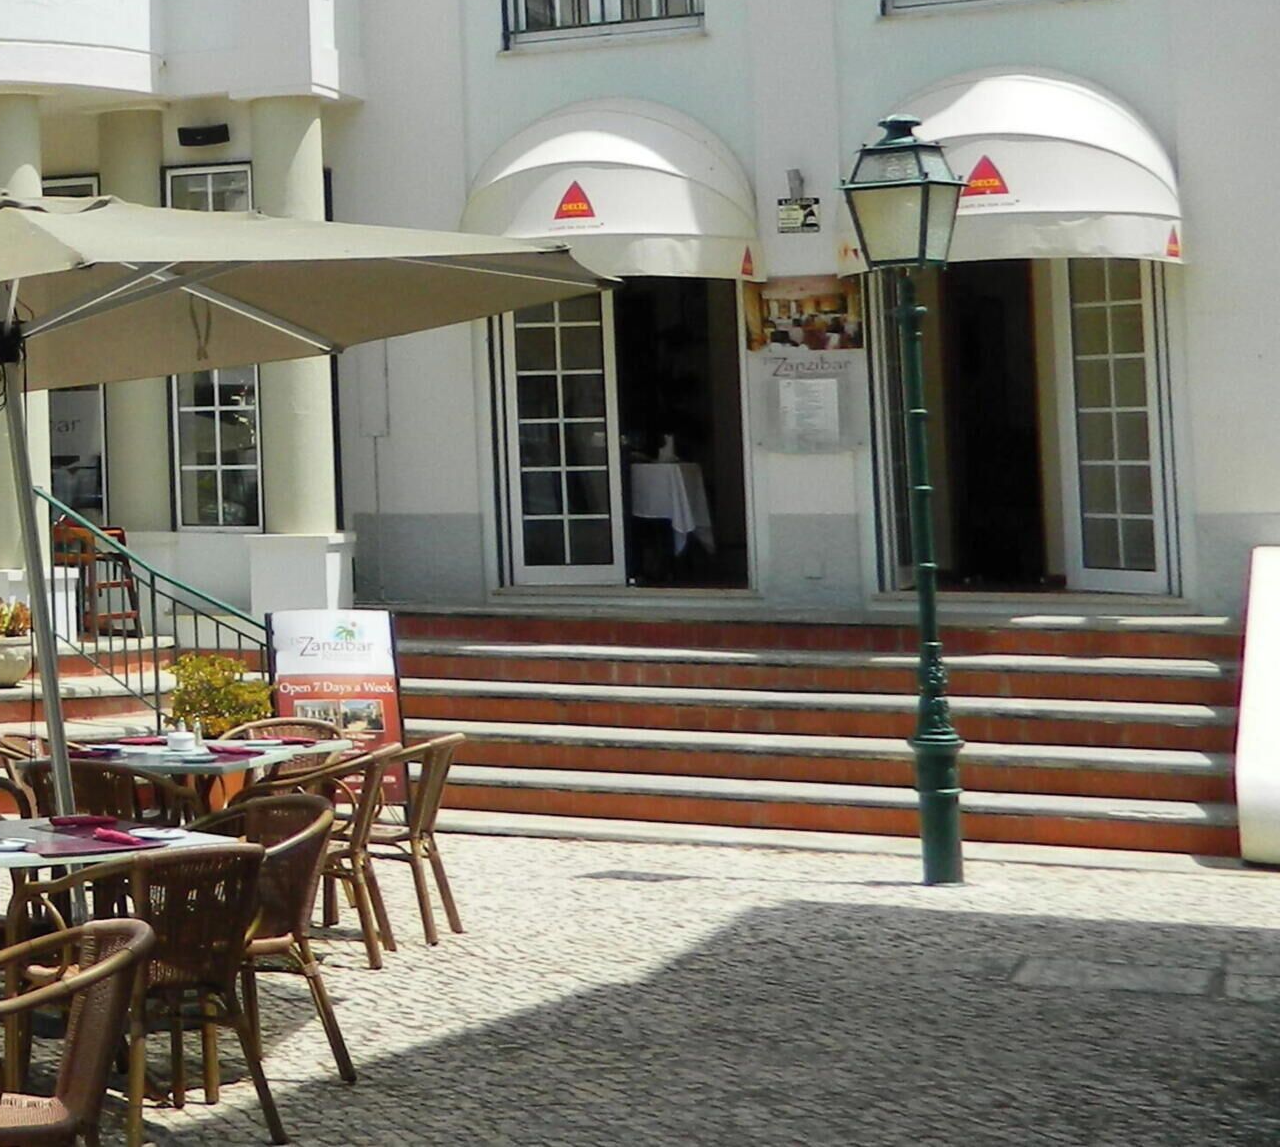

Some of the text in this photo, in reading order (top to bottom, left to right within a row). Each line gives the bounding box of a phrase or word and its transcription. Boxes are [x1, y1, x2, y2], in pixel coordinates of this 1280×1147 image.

[561, 202, 589, 211] DELTA
[772, 356, 852, 377] Zanzibar
[299, 636, 375, 657] Zanzibar
[279, 681, 395, 697] Open 7 Days a Week
